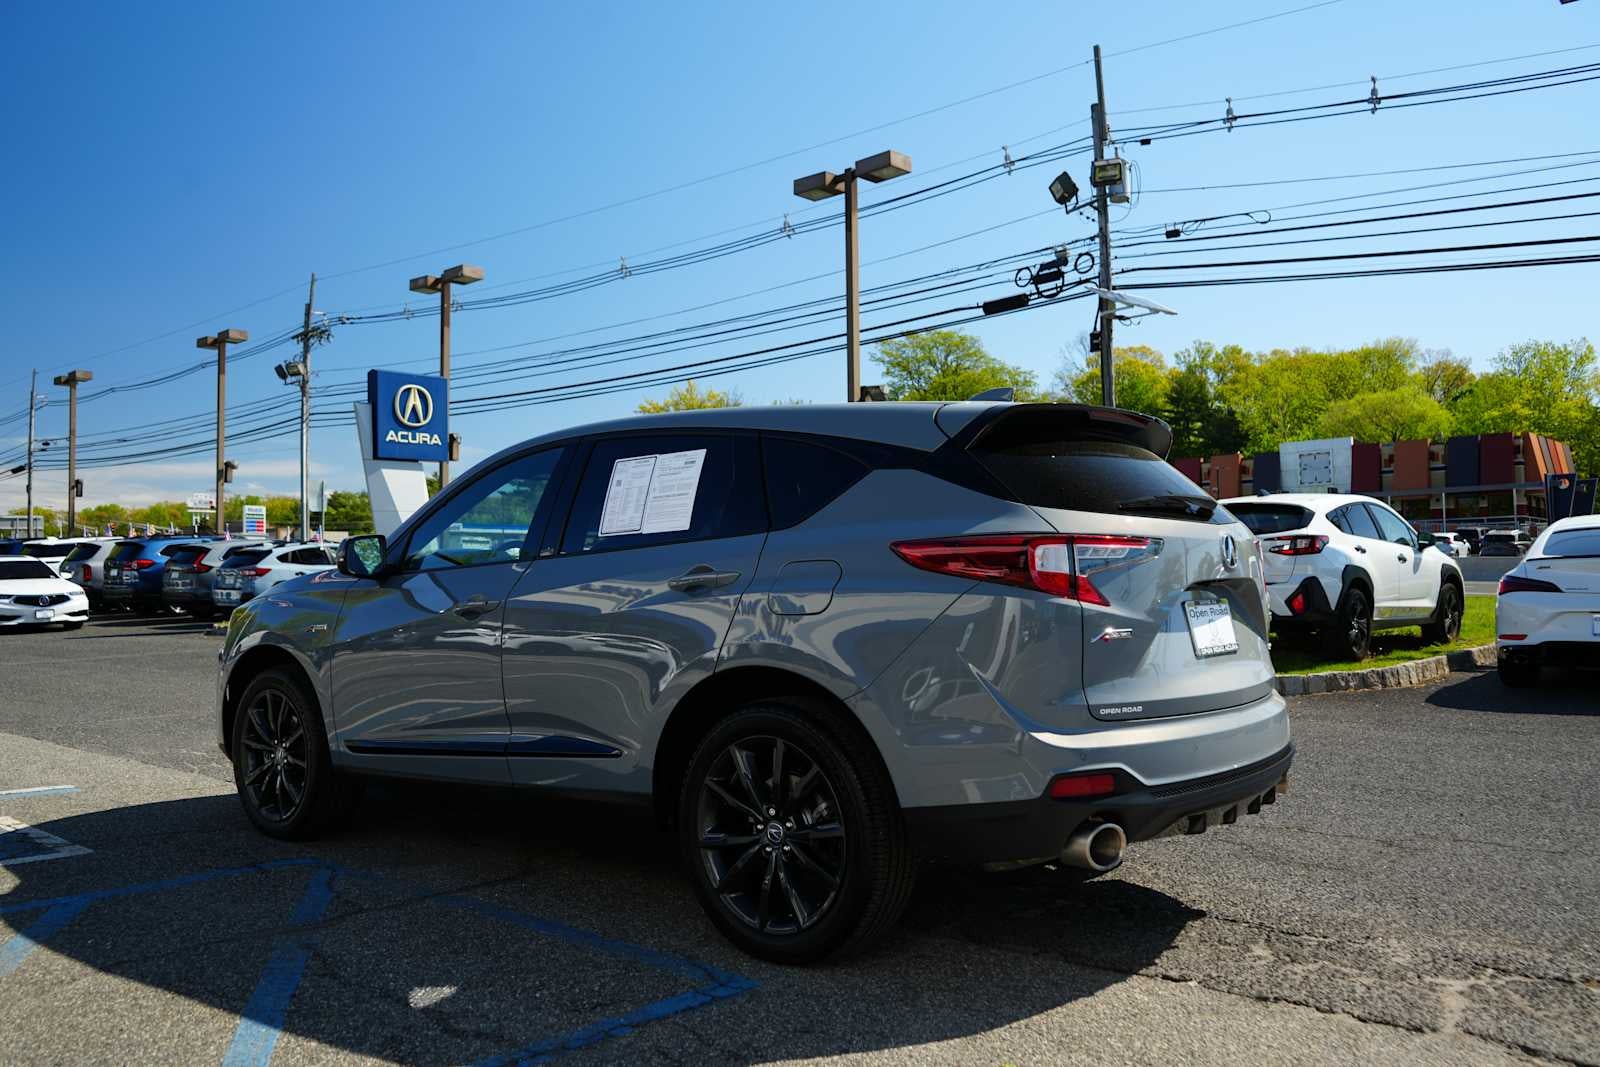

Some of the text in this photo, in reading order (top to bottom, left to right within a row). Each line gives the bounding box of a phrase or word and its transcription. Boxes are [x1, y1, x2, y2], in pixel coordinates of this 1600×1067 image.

[385, 429, 442, 446] ACURA
[1189, 605, 1229, 620] Open Road
[1099, 705, 1143, 715] OPEN ROAD
